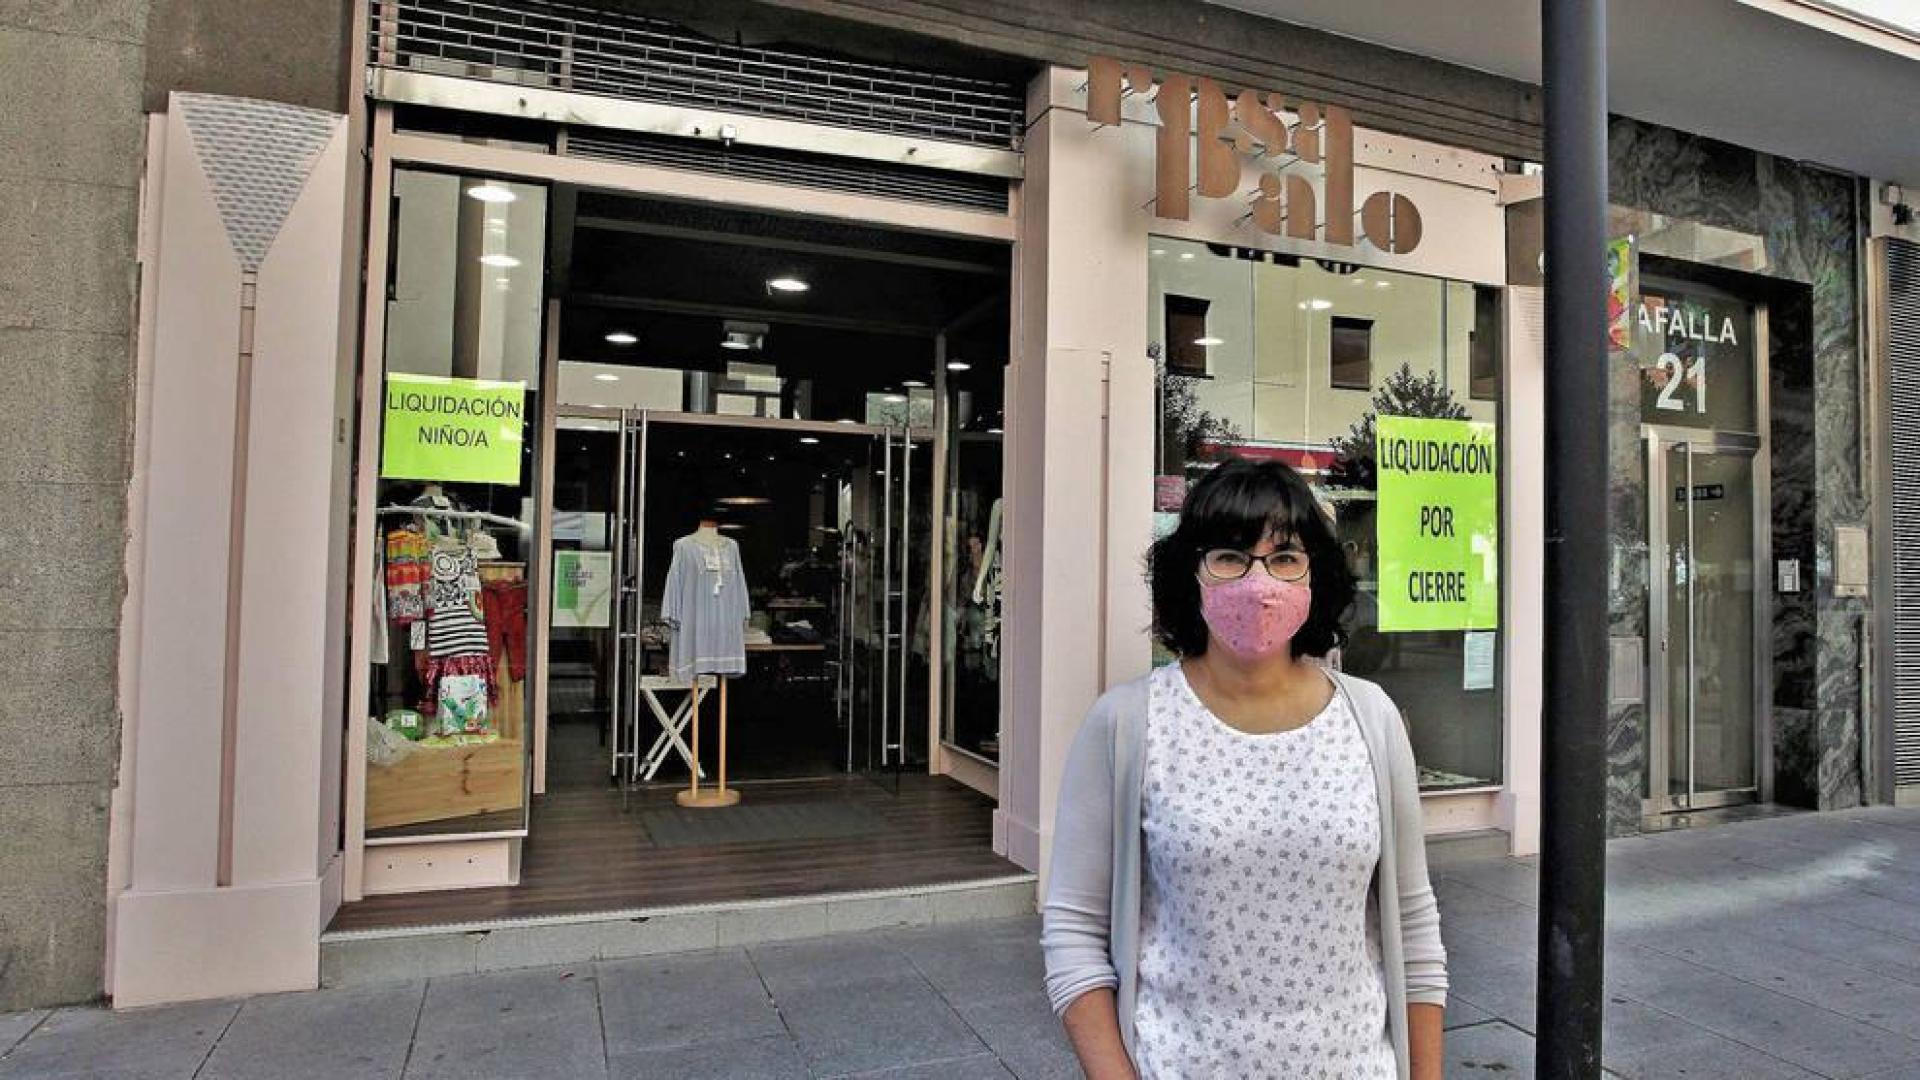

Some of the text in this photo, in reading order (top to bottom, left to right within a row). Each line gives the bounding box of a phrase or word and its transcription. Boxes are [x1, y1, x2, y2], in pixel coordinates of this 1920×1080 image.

[1656, 352, 1706, 414] 21
[389, 391, 521, 418] LIQUIDACIÓN
[418, 424, 489, 448] NIÑO/A
[1380, 436, 1492, 475] LIQUIDACIÓN
[1420, 505, 1455, 537] POR
[1408, 571, 1467, 603] CIERRE
